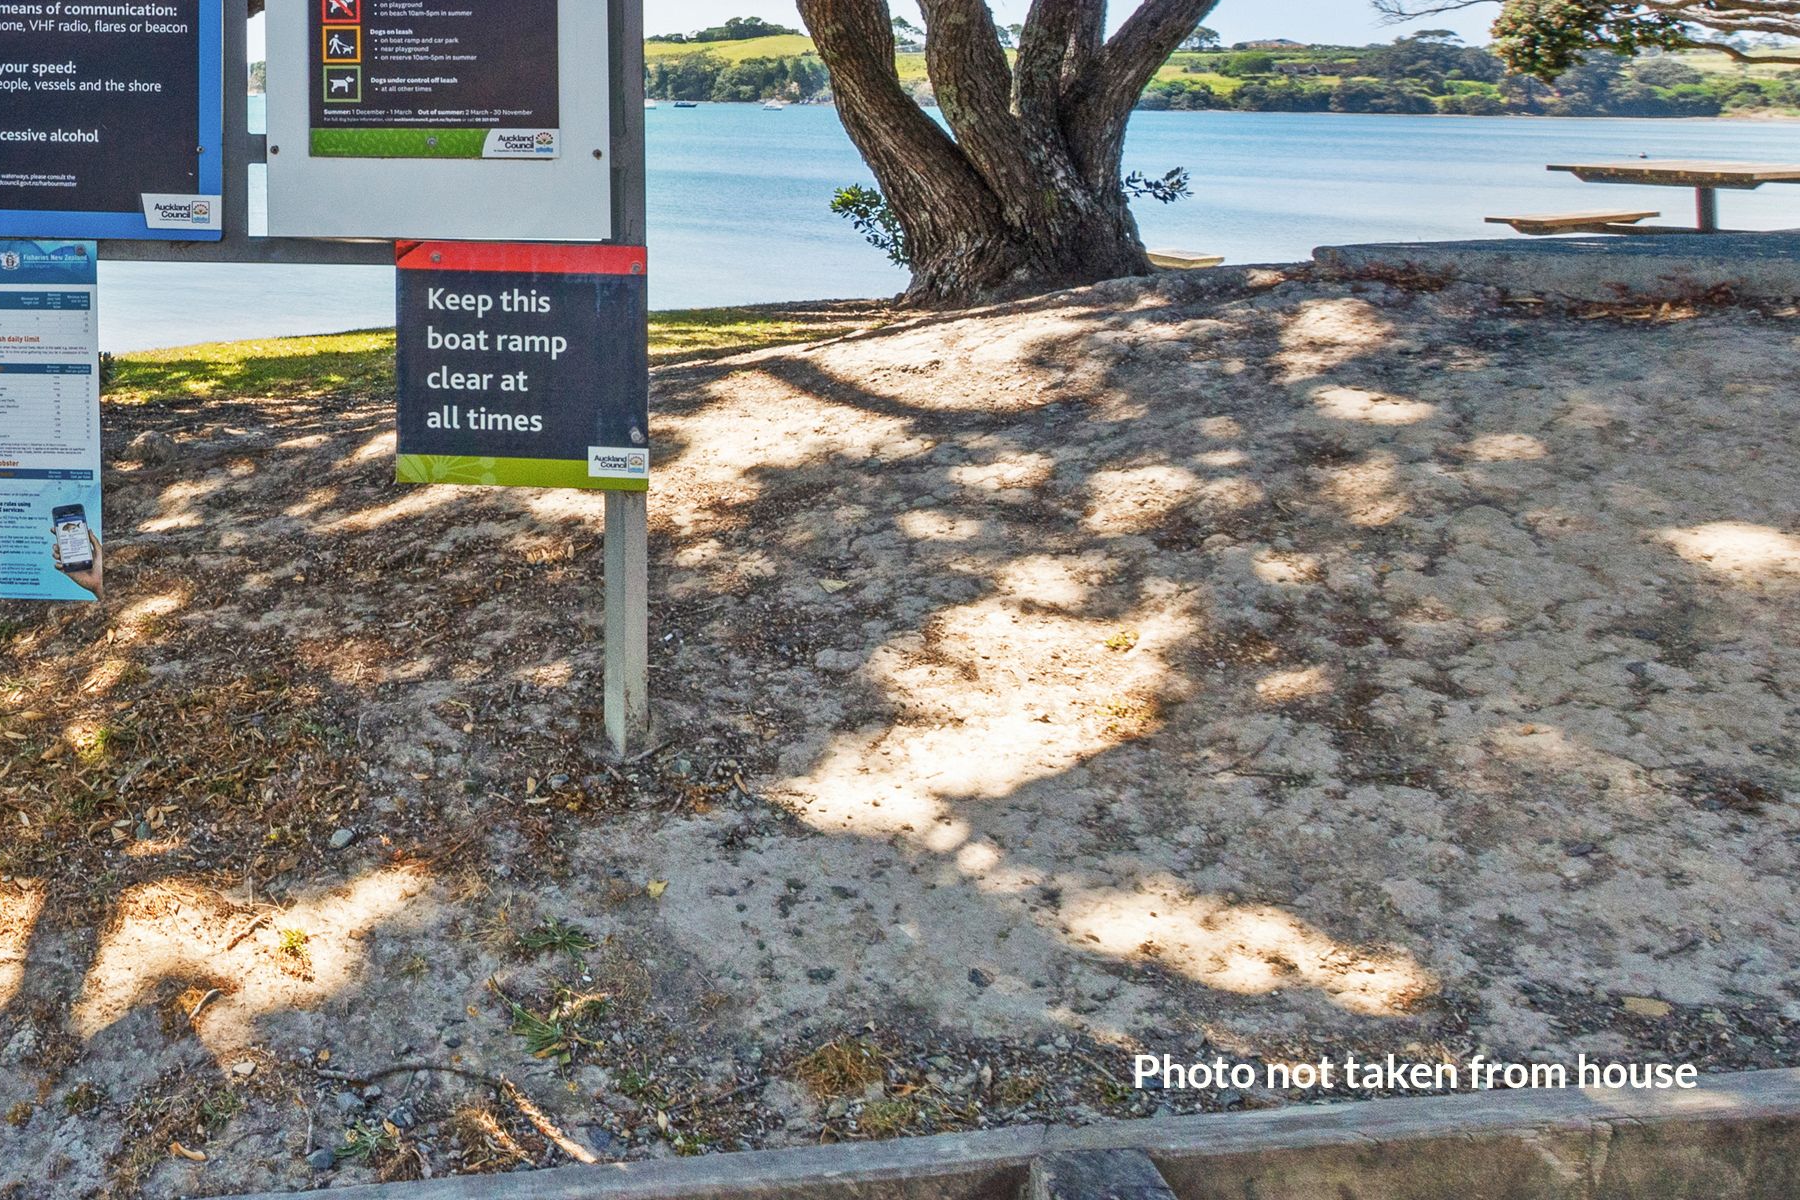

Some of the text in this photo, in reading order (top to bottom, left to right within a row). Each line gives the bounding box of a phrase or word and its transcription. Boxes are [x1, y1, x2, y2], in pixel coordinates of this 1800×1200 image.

[46, 2, 61, 15] of
[64, 3, 177, 16] communication:
[29, 20, 55, 31] VHF
[59, 20, 91, 33] radio,
[95, 20, 126, 32] flares
[129, 24, 142, 33] or
[145, 21, 188, 33] beacon
[32, 61, 76, 77] speed:
[35, 79, 76, 91] vessels
[79, 79, 101, 91] and
[105, 80, 125, 92] the
[129, 80, 162, 92] shore
[371, 77, 387, 85] Dogs
[50, 129, 99, 142] alcohol
[505, 141, 534, 149] Council
[154, 203, 190, 211] Auckland
[161, 210, 190, 218] Council
[428, 288, 550, 318] Keep this
[428, 326, 567, 360] boat ramp
[427, 366, 528, 392] clear at
[427, 405, 543, 432] all times
